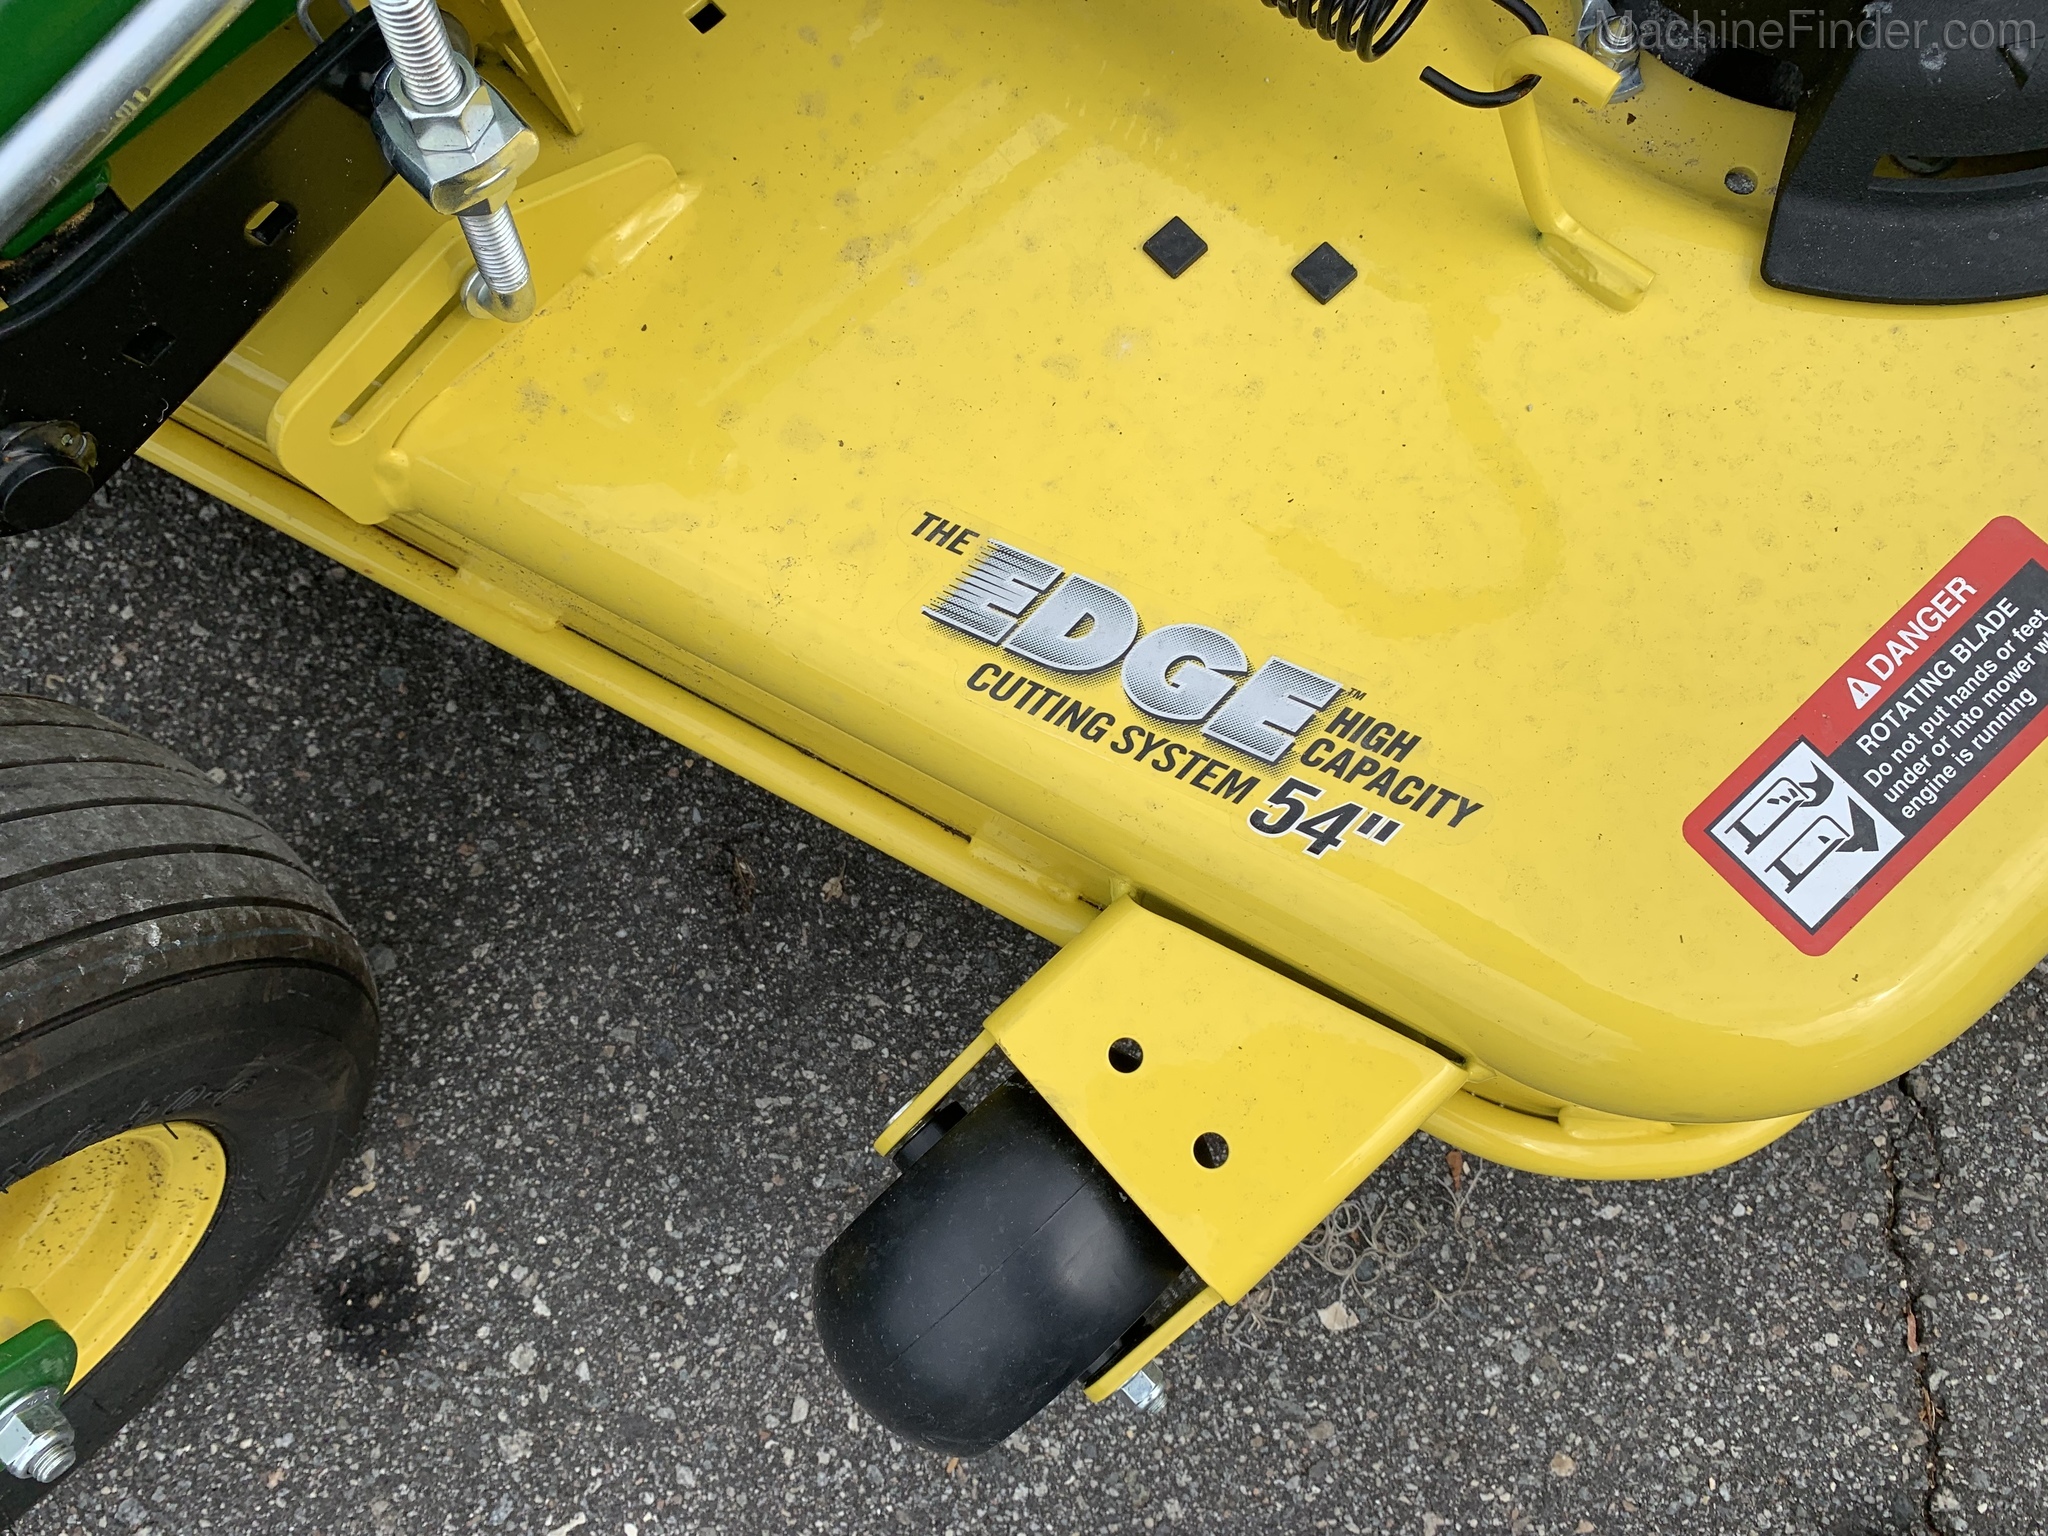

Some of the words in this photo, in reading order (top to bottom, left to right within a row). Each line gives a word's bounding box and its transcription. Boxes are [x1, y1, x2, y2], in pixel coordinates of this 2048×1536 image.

[911, 511, 980, 555] THE
[922, 537, 1344, 767] EDGE
[1856, 660, 1956, 755] ROTATING
[1949, 597, 2020, 664] BLADE
[1865, 577, 1978, 681] DANGER
[966, 663, 1116, 743] CUTTING
[1110, 726, 1261, 805] SYSTEM
[1324, 707, 1422, 763] HIGH
[1863, 762, 1893, 788] Do
[1891, 732, 1922, 764] not
[1919, 705, 1951, 740] put
[1944, 659, 1998, 709] hands
[1996, 639, 2016, 661] or
[2012, 608, 2048, 643] feet
[1883, 754, 1932, 803] under
[1932, 735, 1952, 757] or
[1947, 706, 1984, 738] into
[1982, 653, 2037, 707] mower
[2033, 631, 2048, 655] w
[1901, 765, 1957, 819] engine
[1951, 748, 1974, 767] is
[1971, 688, 2037, 750] running
[1247, 776, 1405, 859] 54"
[1300, 737, 1485, 828] CAPACITY
